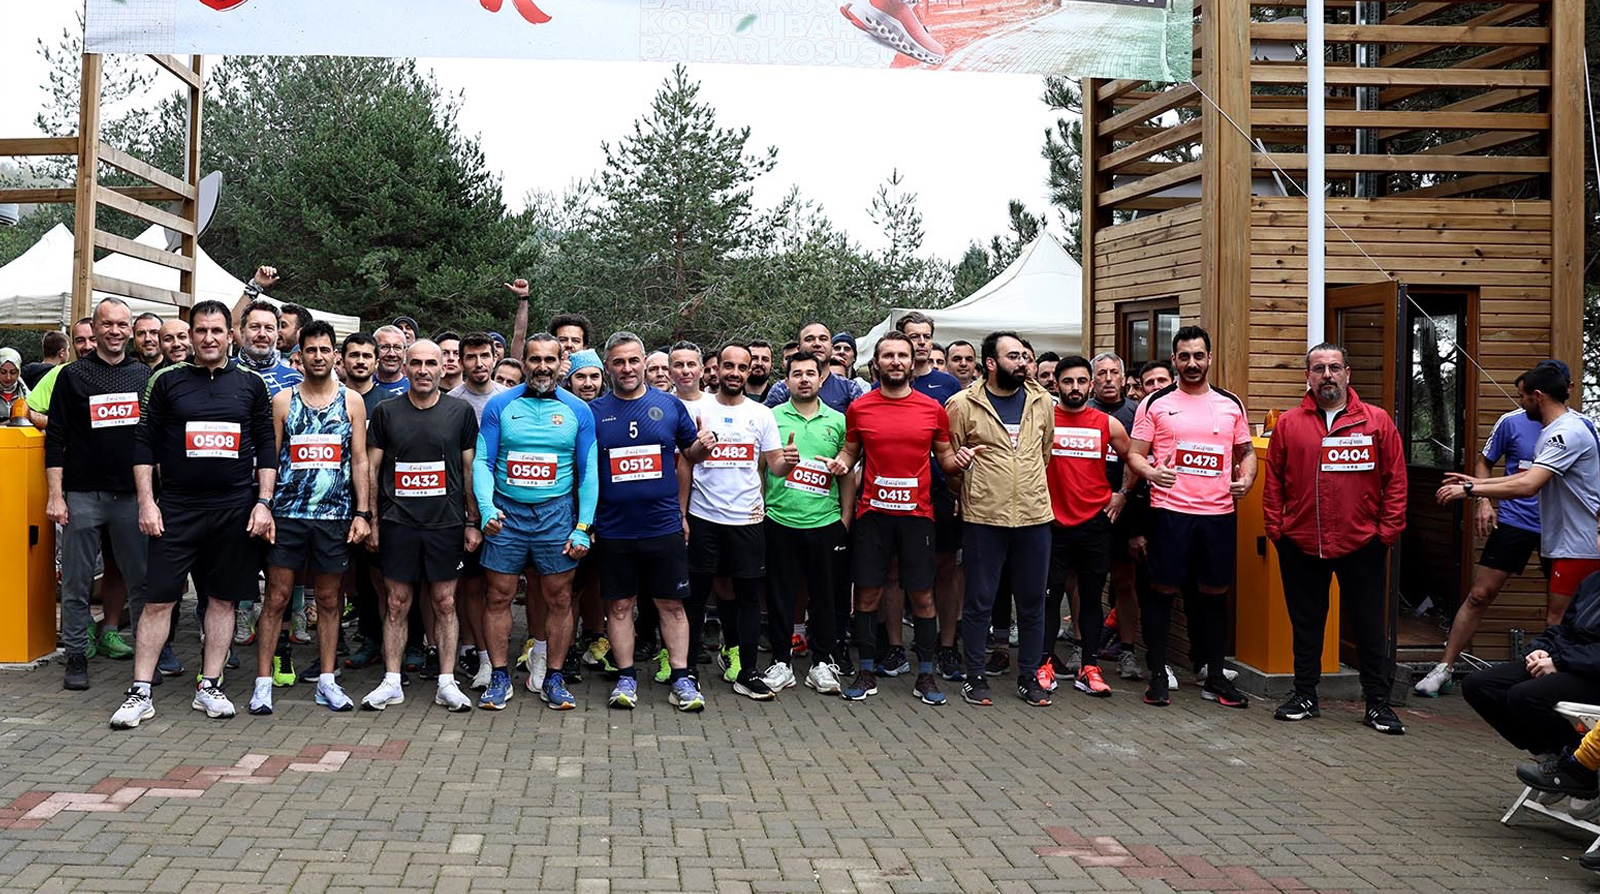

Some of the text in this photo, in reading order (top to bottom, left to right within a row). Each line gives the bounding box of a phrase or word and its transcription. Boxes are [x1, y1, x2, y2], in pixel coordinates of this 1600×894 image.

[640, 34, 761, 61] BAHAR
[98, 404, 133, 418] 0467
[629, 421, 639, 439] 5
[193, 434, 235, 448] 0508
[1059, 437, 1095, 450] 0534
[298, 447, 334, 460] 0510
[711, 446, 748, 458] 0482
[1327, 448, 1370, 462] 0404
[619, 457, 654, 472] 0512
[1182, 453, 1218, 468] 0478
[512, 464, 551, 478] 0506
[793, 469, 827, 486] 0550
[401, 474, 439, 487] 0432
[878, 488, 911, 502] 0413
